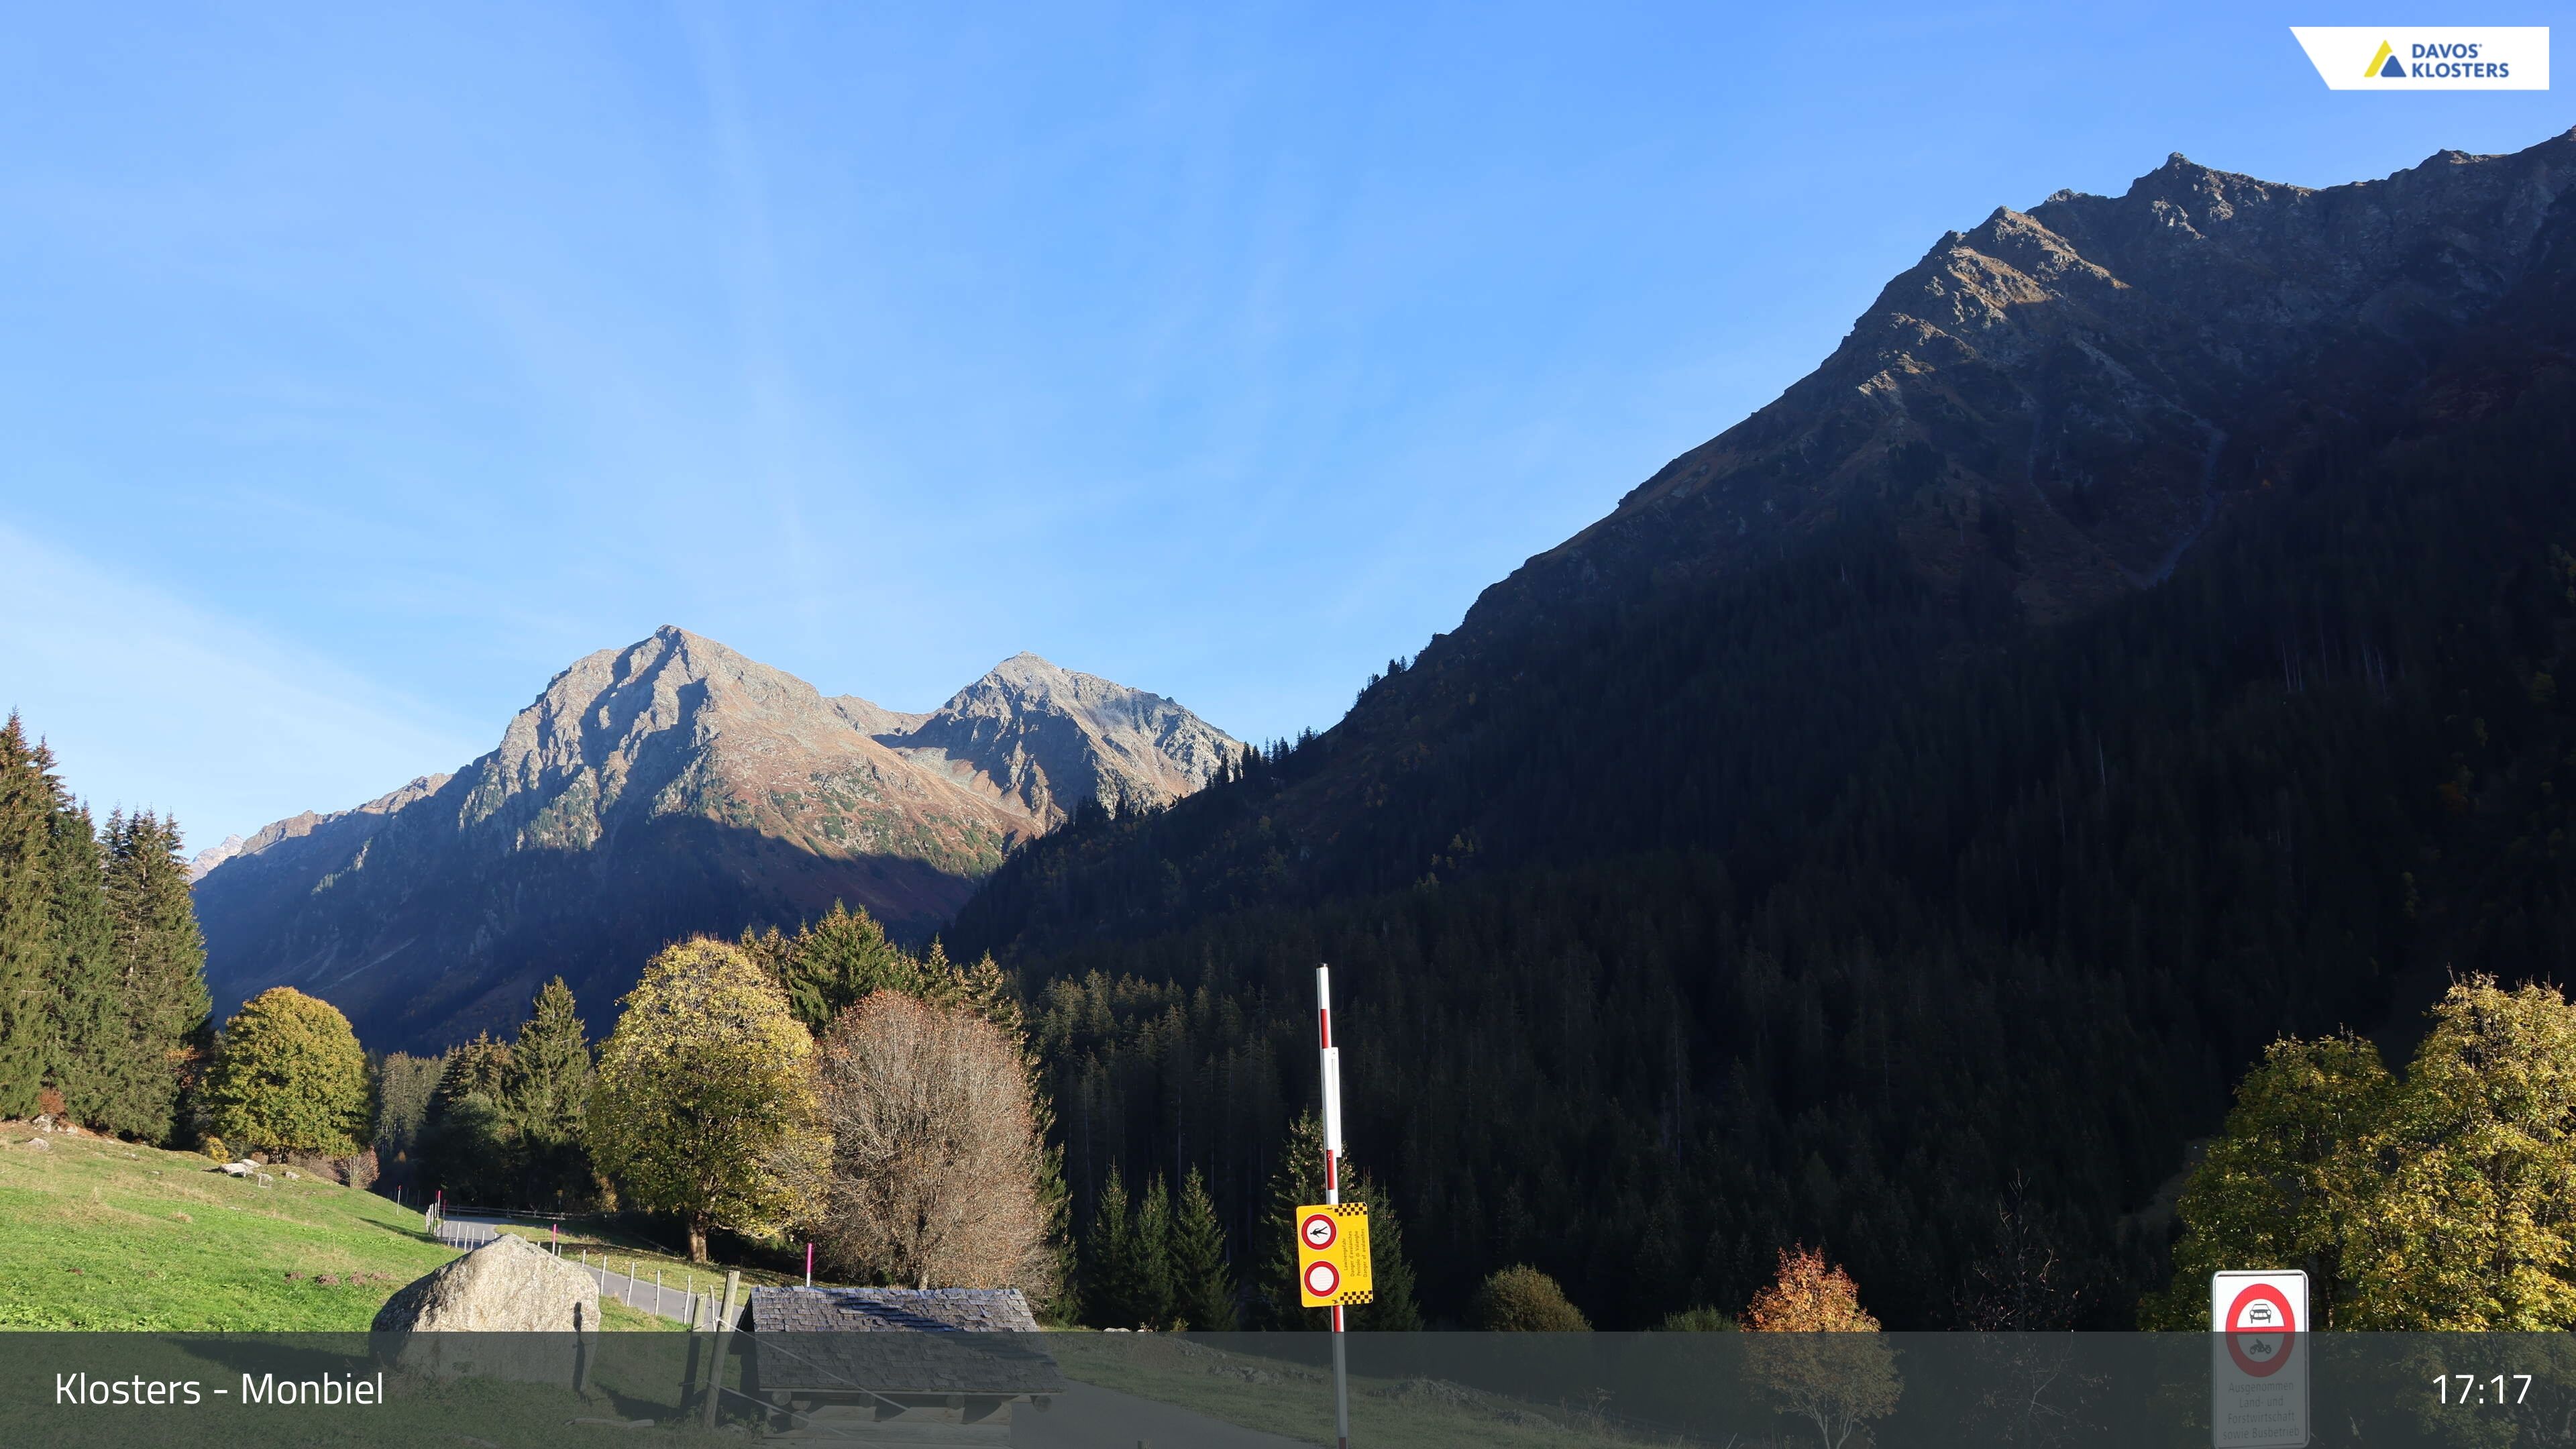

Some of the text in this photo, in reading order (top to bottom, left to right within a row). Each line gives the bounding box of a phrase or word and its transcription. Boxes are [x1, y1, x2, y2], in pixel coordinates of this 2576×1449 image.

[2229, 1382, 2294, 1395] Ausgenommen
[2239, 1395, 2284, 1408] Land- und
[2228, 1409, 2296, 1424] Forstwirtschaft
[2222, 1425, 2300, 1440] sowie Busbetrieb
